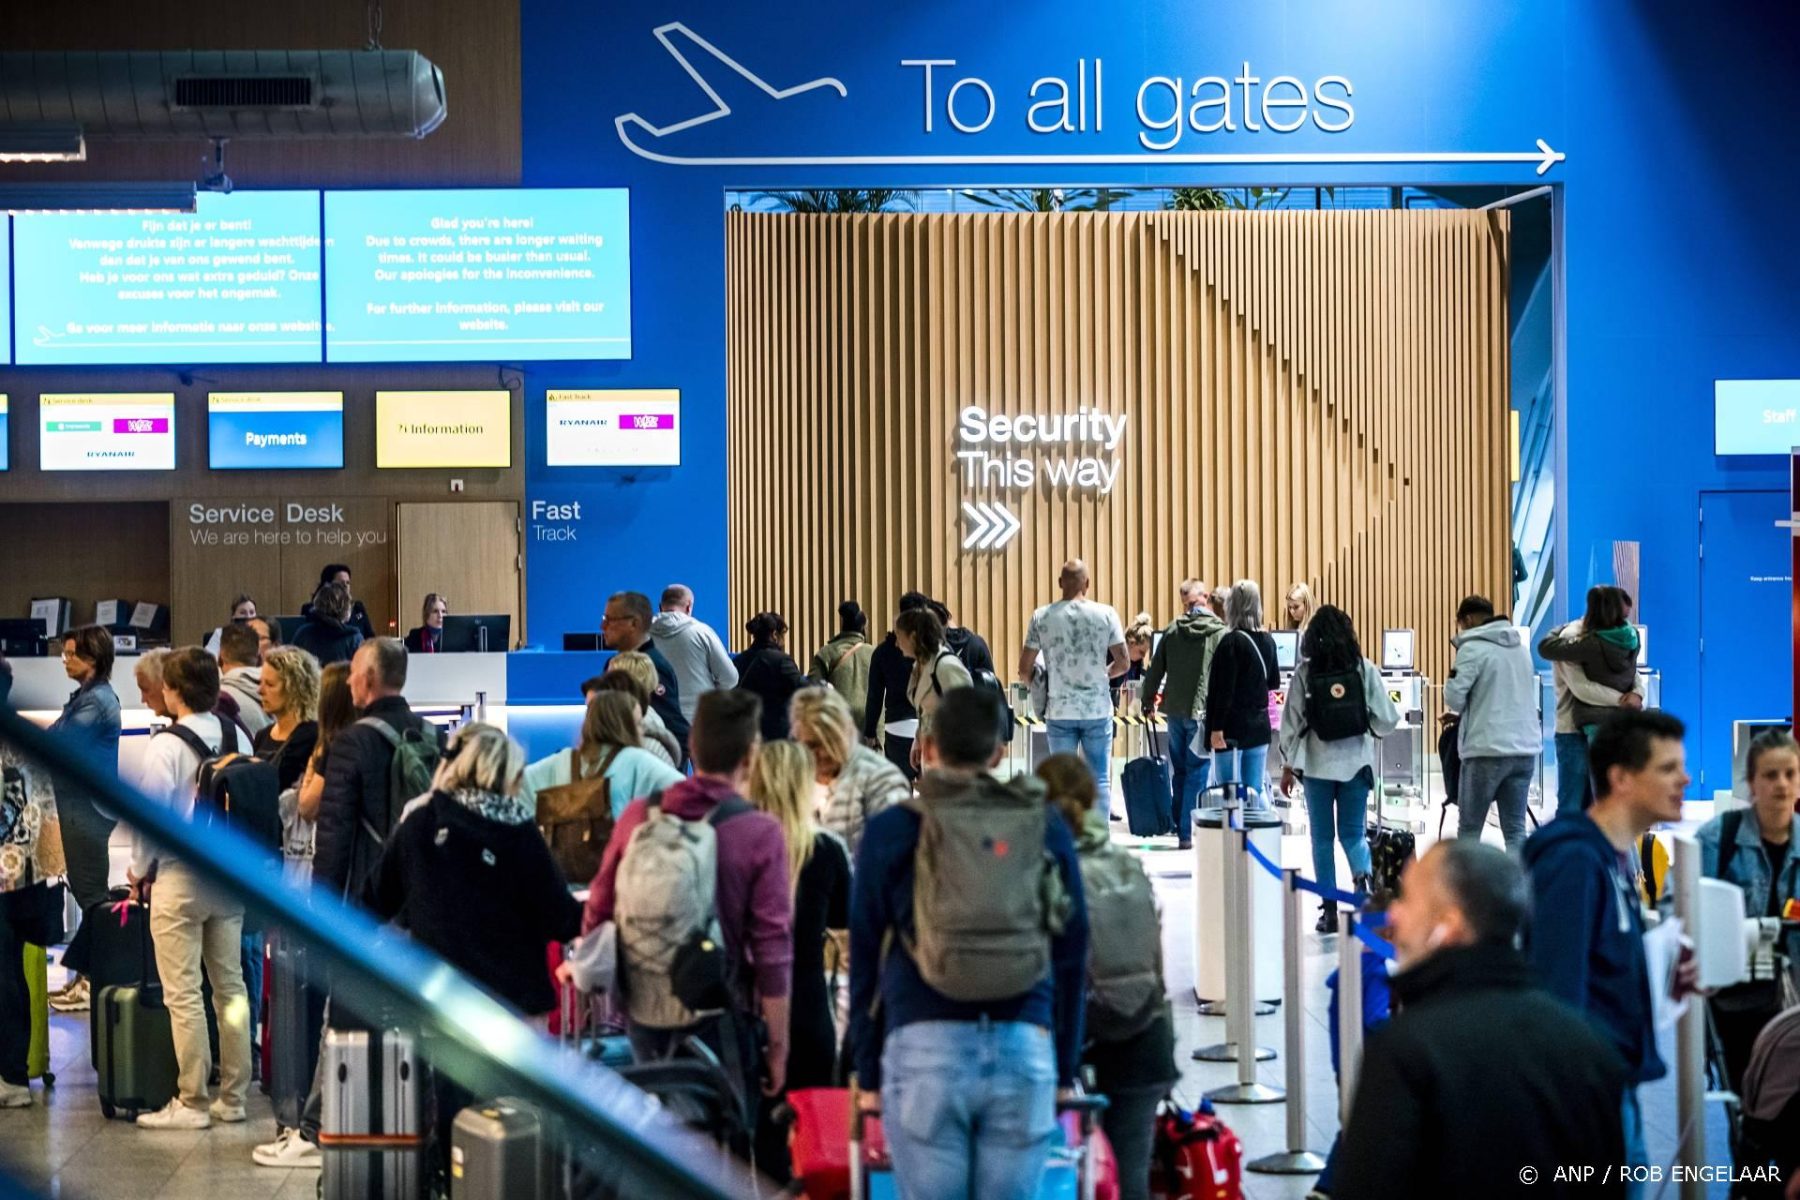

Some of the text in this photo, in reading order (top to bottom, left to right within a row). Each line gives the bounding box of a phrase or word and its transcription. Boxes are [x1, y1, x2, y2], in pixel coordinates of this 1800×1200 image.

[901, 58, 1355, 151] To all gates
[190, 220, 202, 233] je
[431, 217, 458, 229] Glad
[462, 217, 500, 231] you're
[127, 237, 167, 249] drukte
[366, 233, 603, 248] Due to crowds, there are longer waiting
[148, 255, 160, 267] je
[163, 256, 185, 265] van
[187, 255, 209, 265] ons
[378, 252, 414, 264] times.
[430, 251, 463, 263] could
[467, 251, 482, 262] be
[485, 250, 522, 262] busier
[525, 250, 552, 262] than
[556, 249, 591, 261] usual.
[107, 272, 119, 285] je
[374, 267, 595, 283] Our apologies for the inconvenience.
[198, 288, 218, 299] het
[366, 301, 604, 315] For further information, please visit our
[459, 318, 508, 331] website.
[1762, 408, 1796, 423] Staff
[411, 423, 483, 435] Information
[960, 405, 1127, 450] Security
[245, 432, 307, 448] Payments
[957, 451, 1121, 494] This way
[189, 502, 344, 524] Service Desk
[532, 500, 581, 520] Fast
[190, 527, 386, 548] We are here to help you
[532, 524, 577, 542] Track
